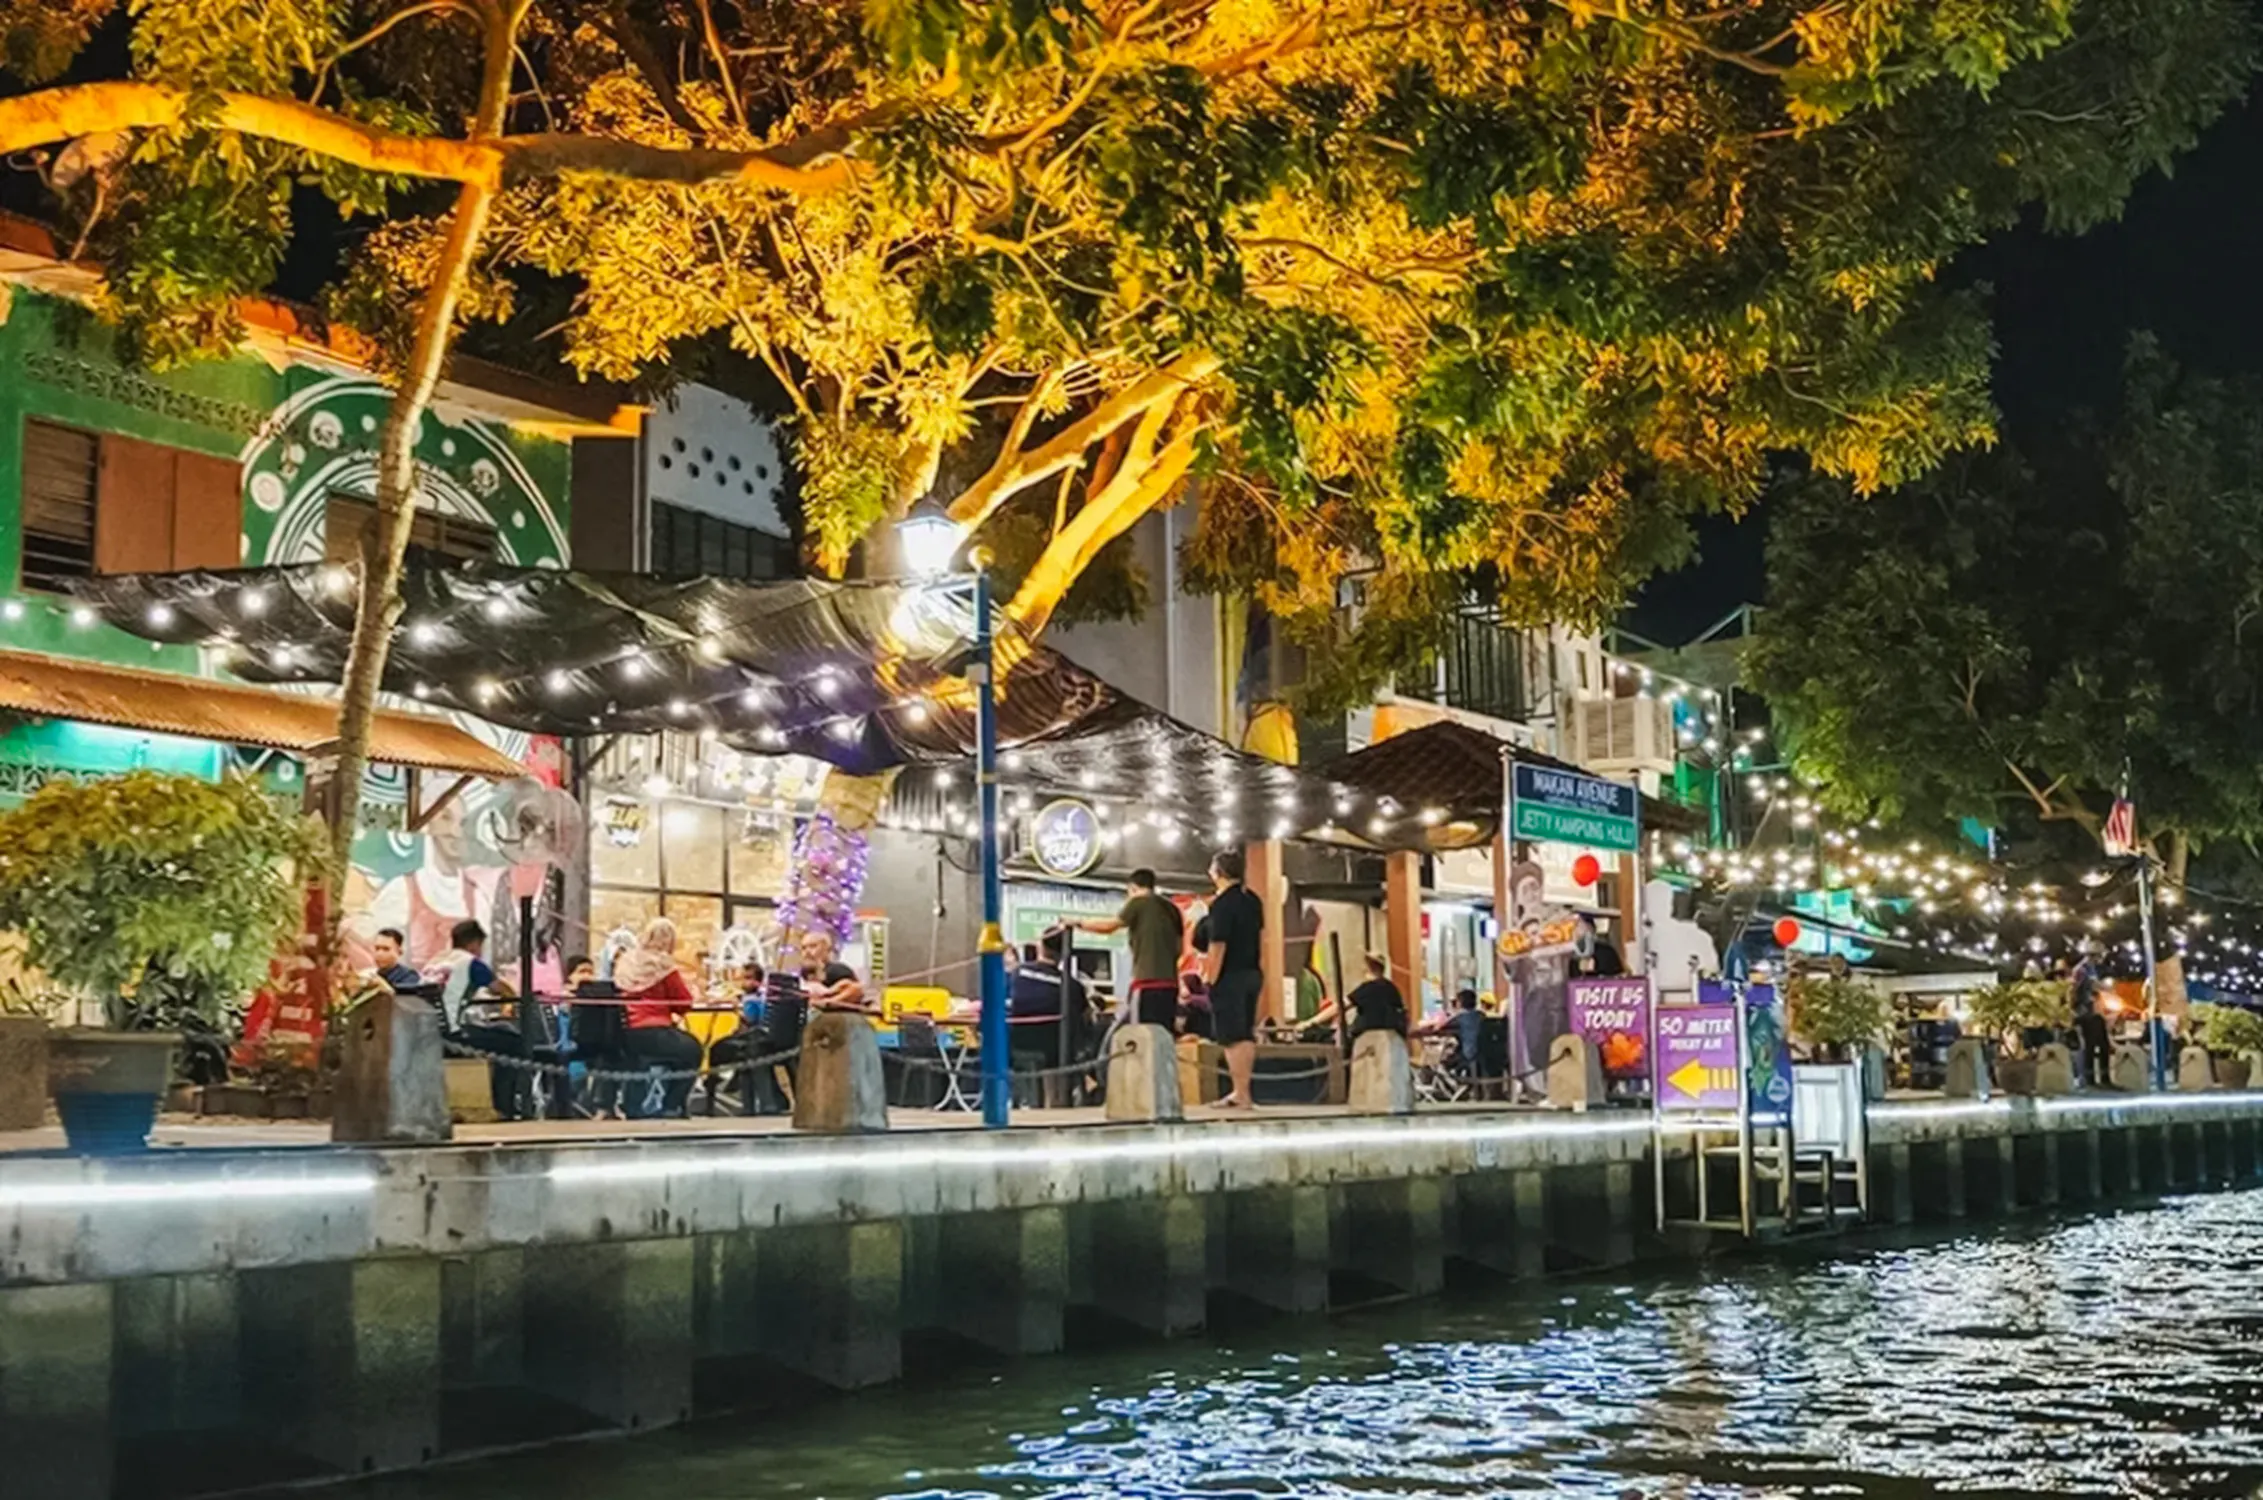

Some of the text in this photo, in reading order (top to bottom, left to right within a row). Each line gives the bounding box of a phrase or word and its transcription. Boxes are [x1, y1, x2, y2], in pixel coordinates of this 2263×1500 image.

[1577, 778, 1619, 807] AVENUE
[1554, 815, 1604, 840] KAMPUNG
[1574, 986, 1644, 1006] VISIT US
[1584, 1009, 1637, 1030] TODAY
[1686, 1018, 1733, 1036] METER
